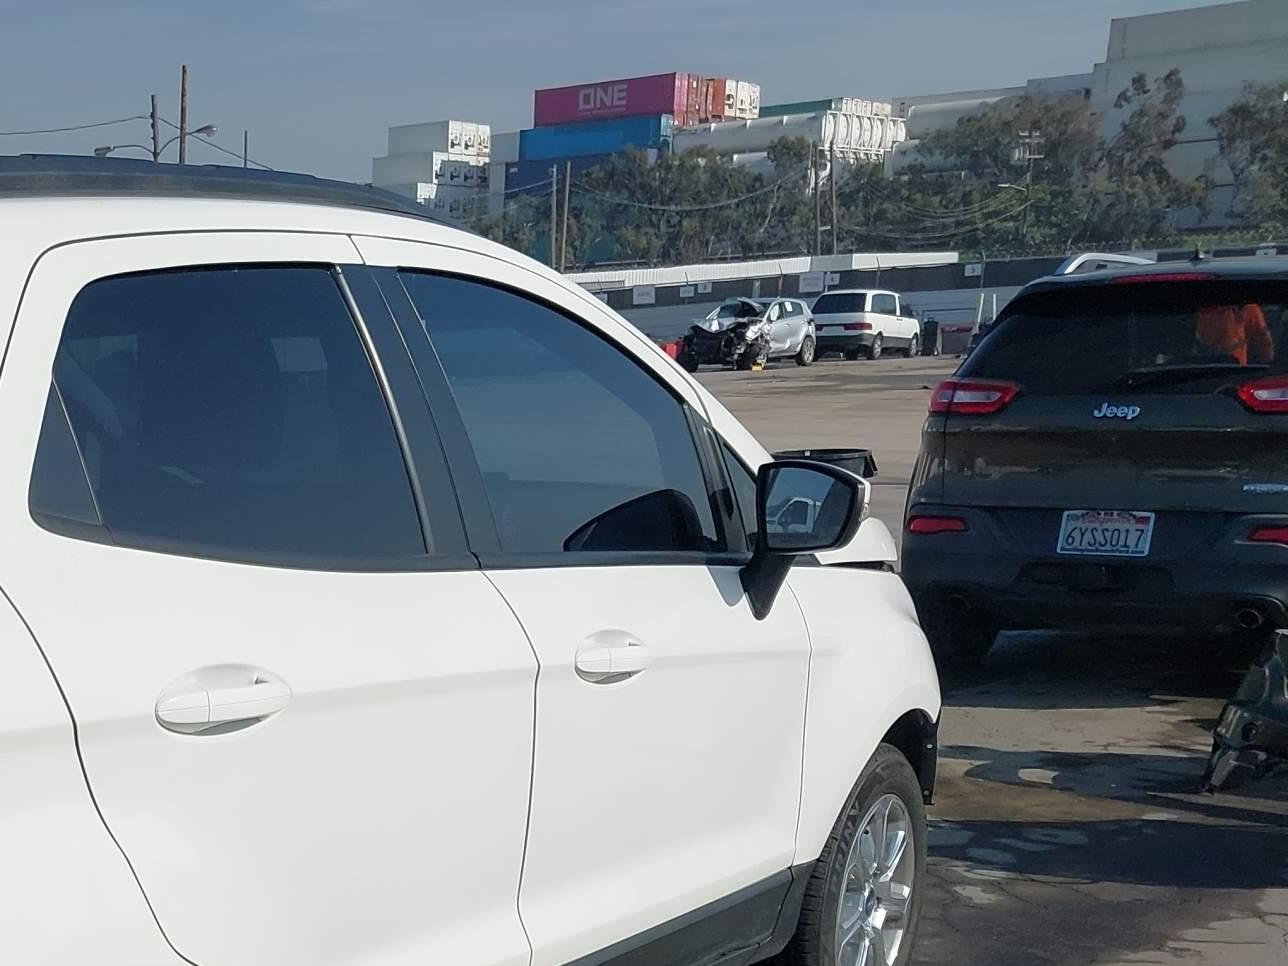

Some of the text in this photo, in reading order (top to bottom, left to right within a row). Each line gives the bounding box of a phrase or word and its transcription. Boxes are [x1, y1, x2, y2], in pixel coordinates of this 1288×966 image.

[578, 84, 628, 110] ONE
[1093, 402, 1141, 420] Jeep
[1065, 526, 1146, 549] 6YSS017
